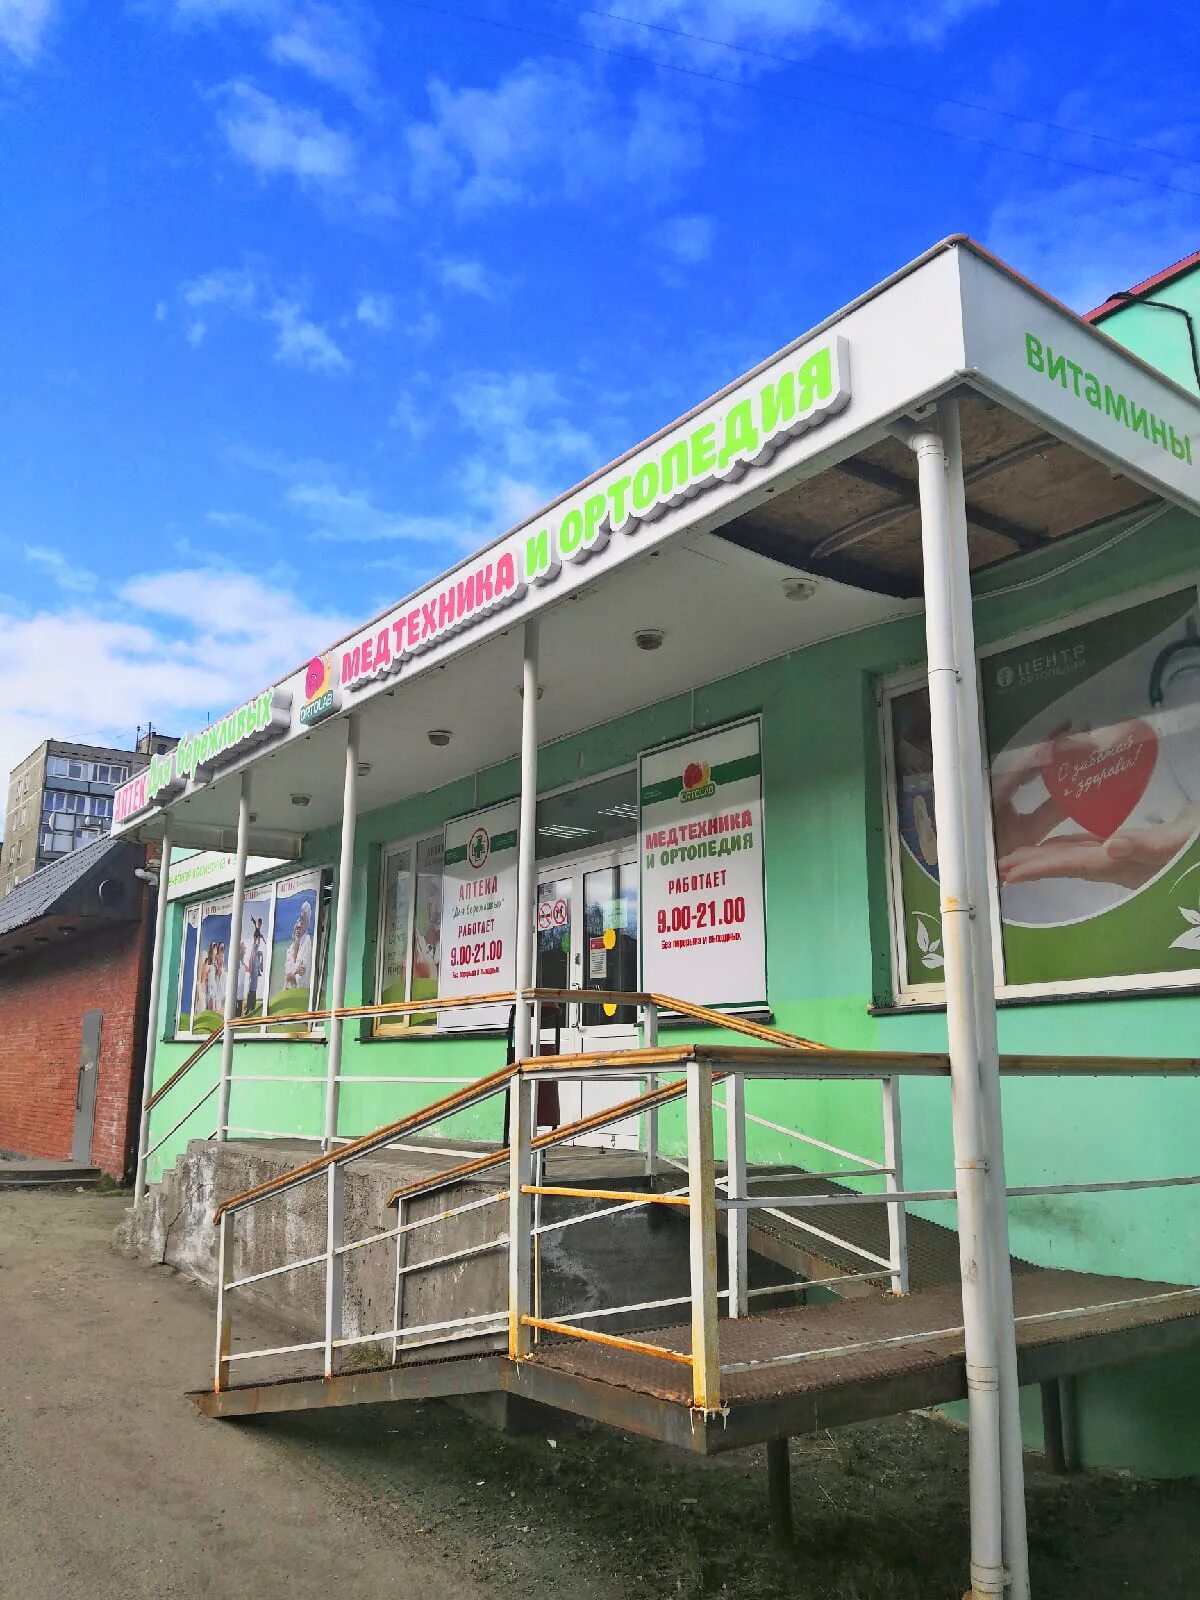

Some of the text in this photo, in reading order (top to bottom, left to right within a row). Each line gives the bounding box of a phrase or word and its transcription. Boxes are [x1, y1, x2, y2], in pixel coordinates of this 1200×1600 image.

[341, 552, 515, 685] МЕДТЕХНИКА
[559, 346, 833, 554] ОРТОПЕДИЯ
[1018, 644, 1086, 677] ЦЕНТР
[300, 692, 334, 722] ORTOLAB
[176, 690, 274, 780] бережливых
[645, 809, 753, 850] МЕДТЕХНИКА
[660, 832, 754, 866] ОРТОПЕДИЯ
[458, 875, 498, 901] АПТЕКА
[668, 869, 727, 895] РАБОТАЕТ
[458, 918, 495, 938] РАБОТАЕТ
[657, 896, 746, 934] 9.00-21.00
[450, 939, 503, 967] 9.00-21.00
